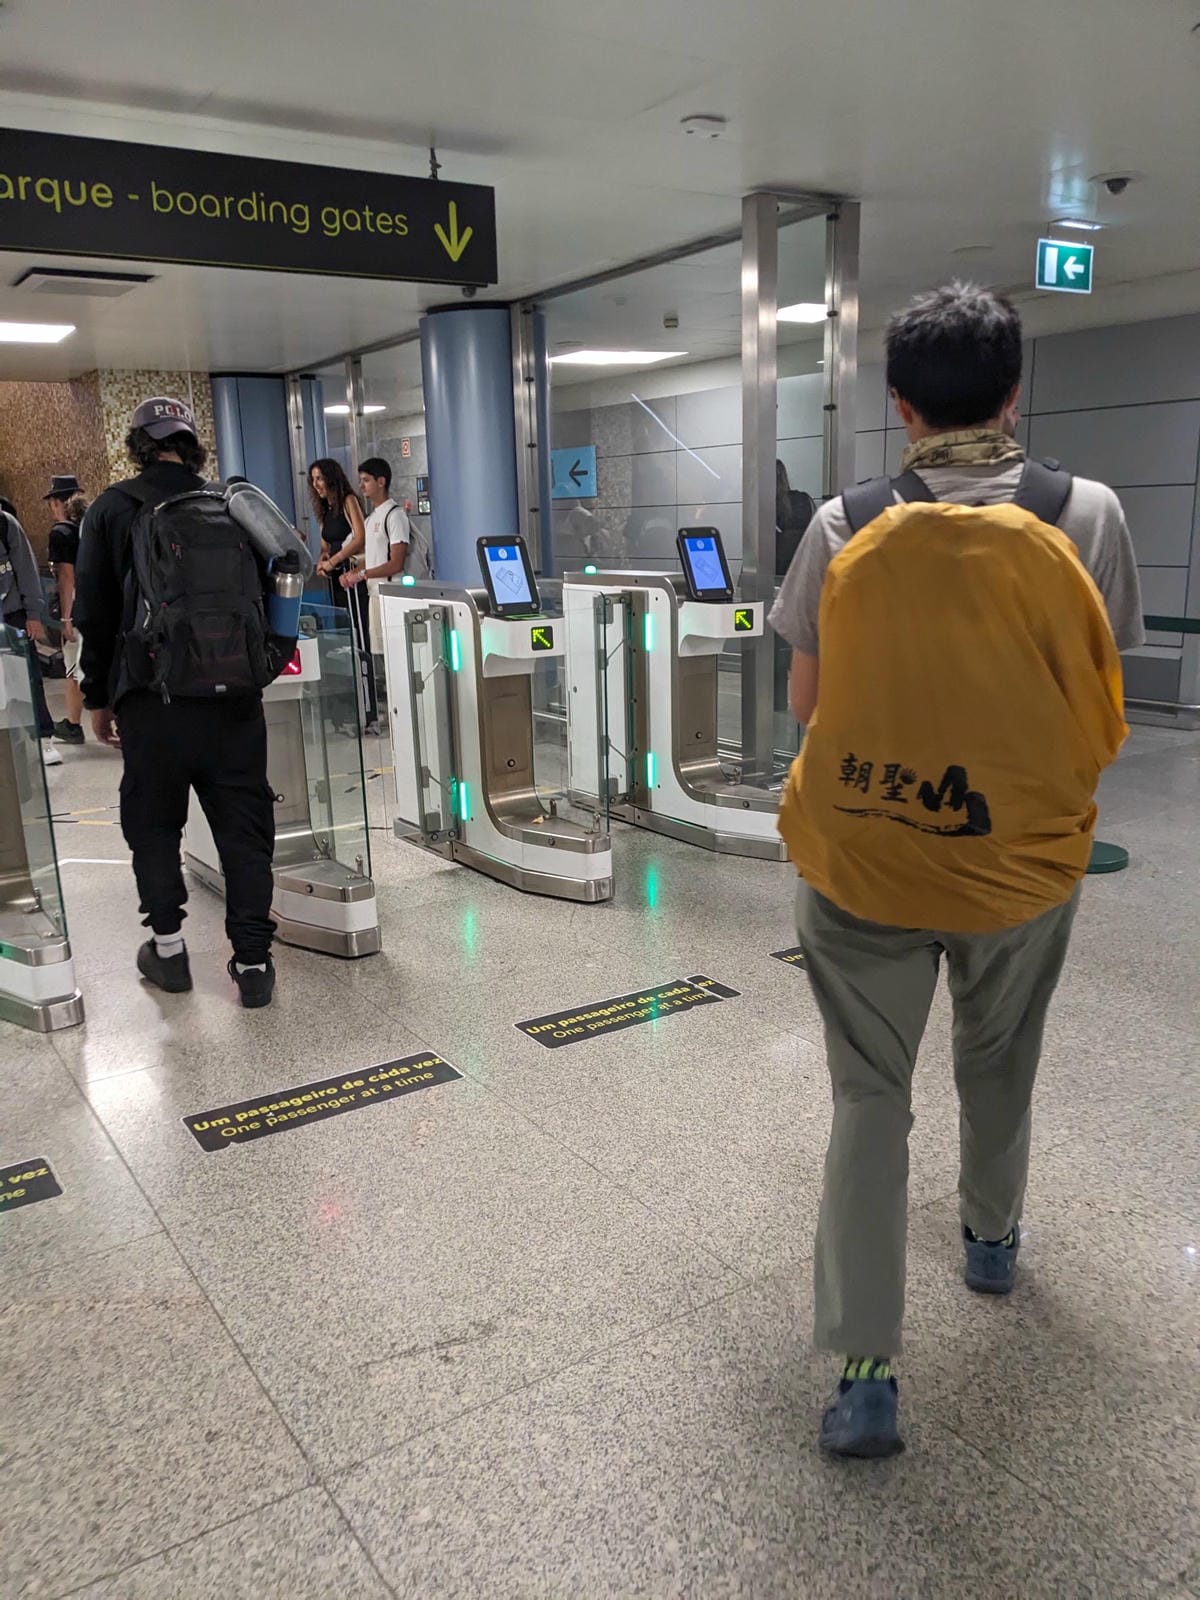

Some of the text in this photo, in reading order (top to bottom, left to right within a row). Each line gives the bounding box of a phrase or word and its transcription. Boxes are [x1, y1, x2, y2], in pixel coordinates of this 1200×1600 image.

[151, 181, 310, 234] boarding
[321, 205, 409, 237] gates
[153, 404, 193, 423] POLO
[526, 1022, 556, 1034] Um
[558, 1000, 636, 1027] passageiro
[637, 996, 656, 1004] de
[657, 986, 691, 999] cada
[552, 1026, 585, 1039] One
[586, 1006, 655, 1031] passenger
[193, 1057, 443, 1131] Um passageiro de cada vez
[221, 1072, 435, 1137] One passenger at a time
[8, 1167, 49, 1184] vez
